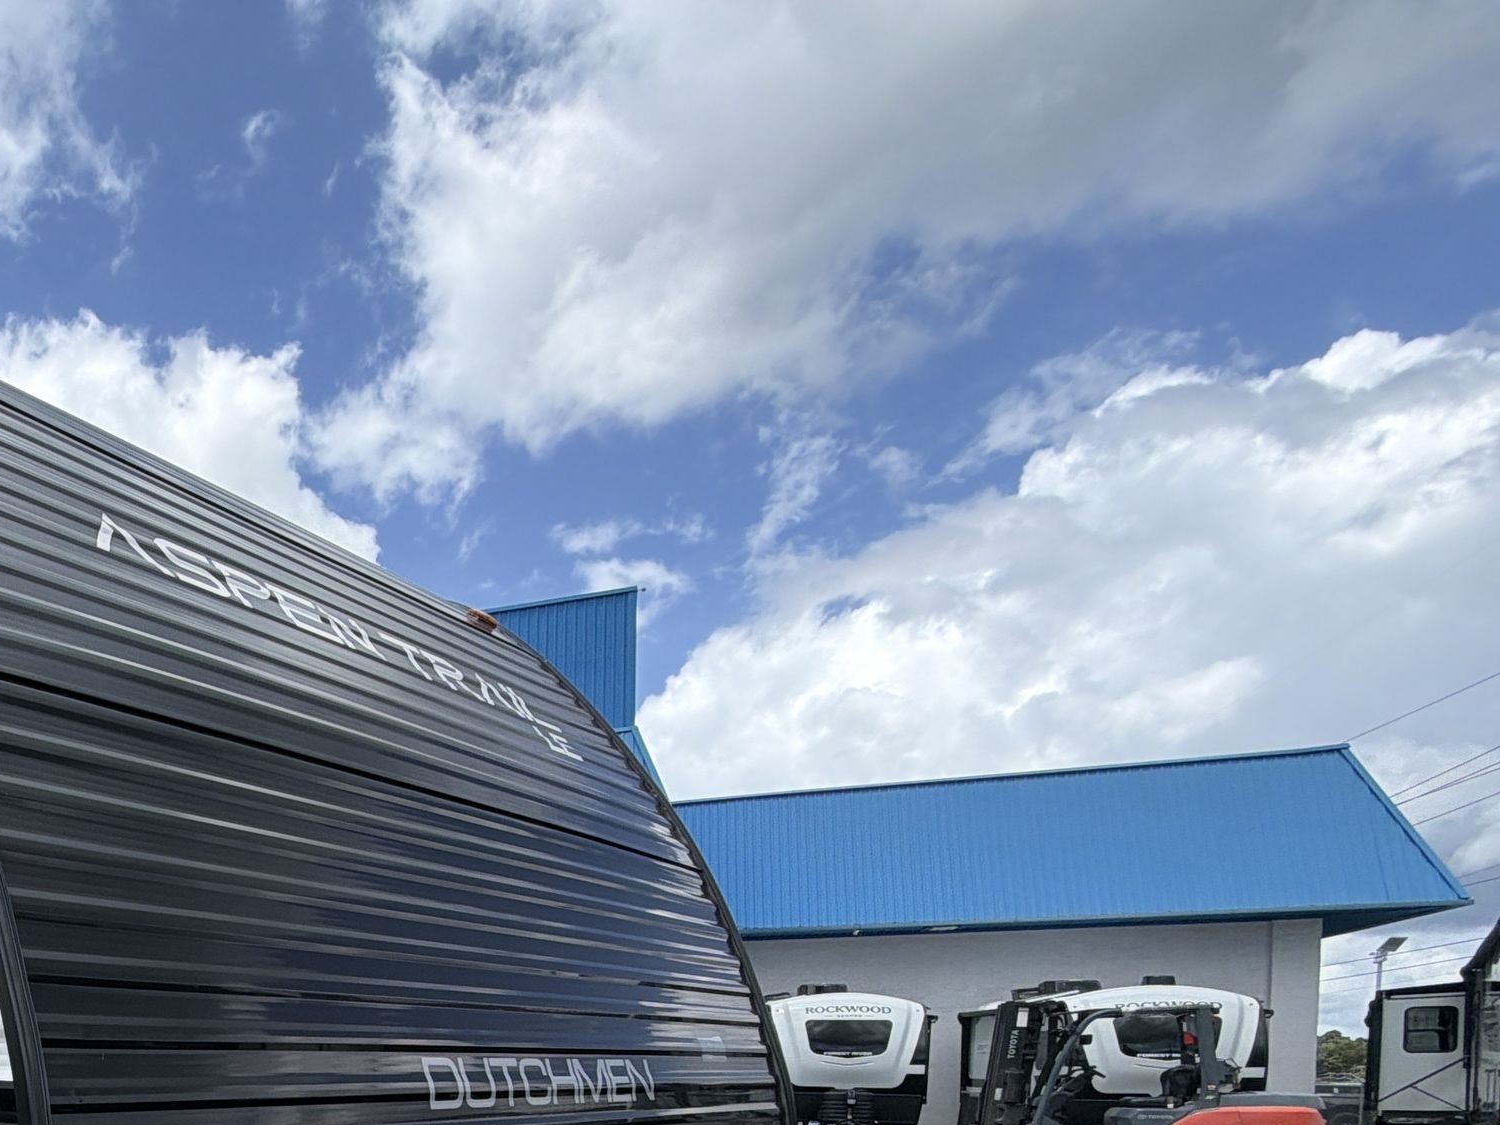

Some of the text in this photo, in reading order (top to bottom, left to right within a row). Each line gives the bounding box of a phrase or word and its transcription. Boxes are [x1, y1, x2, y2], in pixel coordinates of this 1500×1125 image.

[97, 513, 563, 733] ASPEN TRAIL
[532, 725, 584, 761] LE
[805, 1006, 892, 1014] ROCKWOOD
[1007, 1030, 1020, 1058] TOYOTA
[421, 1057, 655, 1110] DUTCHMEN
